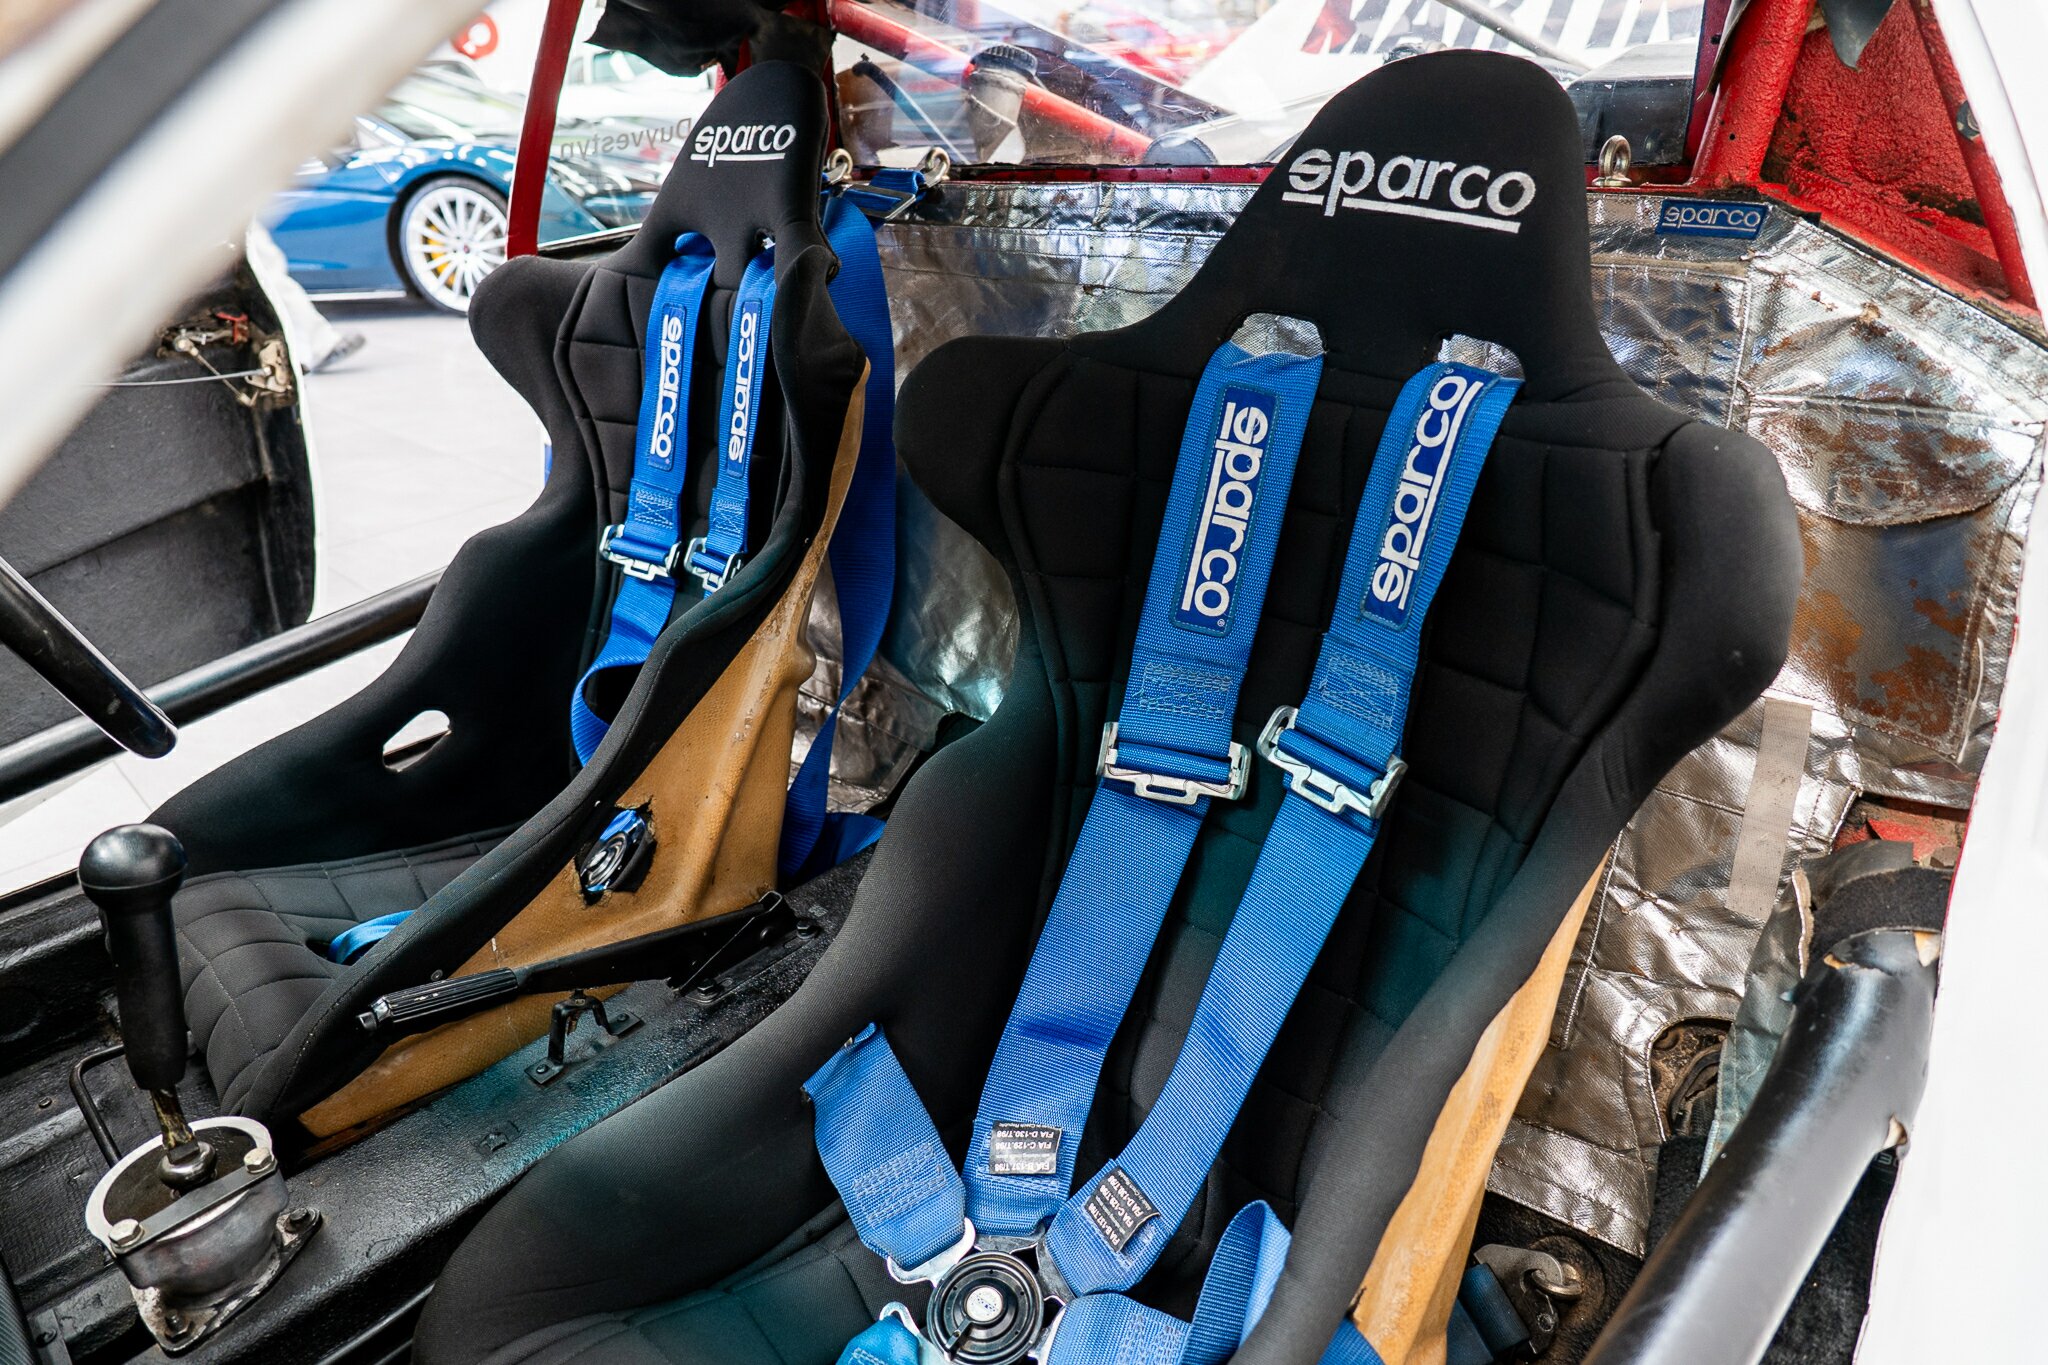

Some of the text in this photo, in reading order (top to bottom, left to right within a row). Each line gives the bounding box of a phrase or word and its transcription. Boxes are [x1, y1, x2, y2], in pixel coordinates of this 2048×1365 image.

[692, 124, 797, 167] sparco
[1283, 147, 1536, 232] sparco
[1663, 203, 1762, 231] sparco
[651, 314, 683, 459] sparco
[728, 311, 757, 463] sparco
[1181, 401, 1269, 616] sparco
[1372, 374, 1484, 611] sparco
[1109, 1230, 1120, 1246] FIA
[1122, 1212, 1134, 1228] FIA
[1131, 1203, 1144, 1217] FIA
